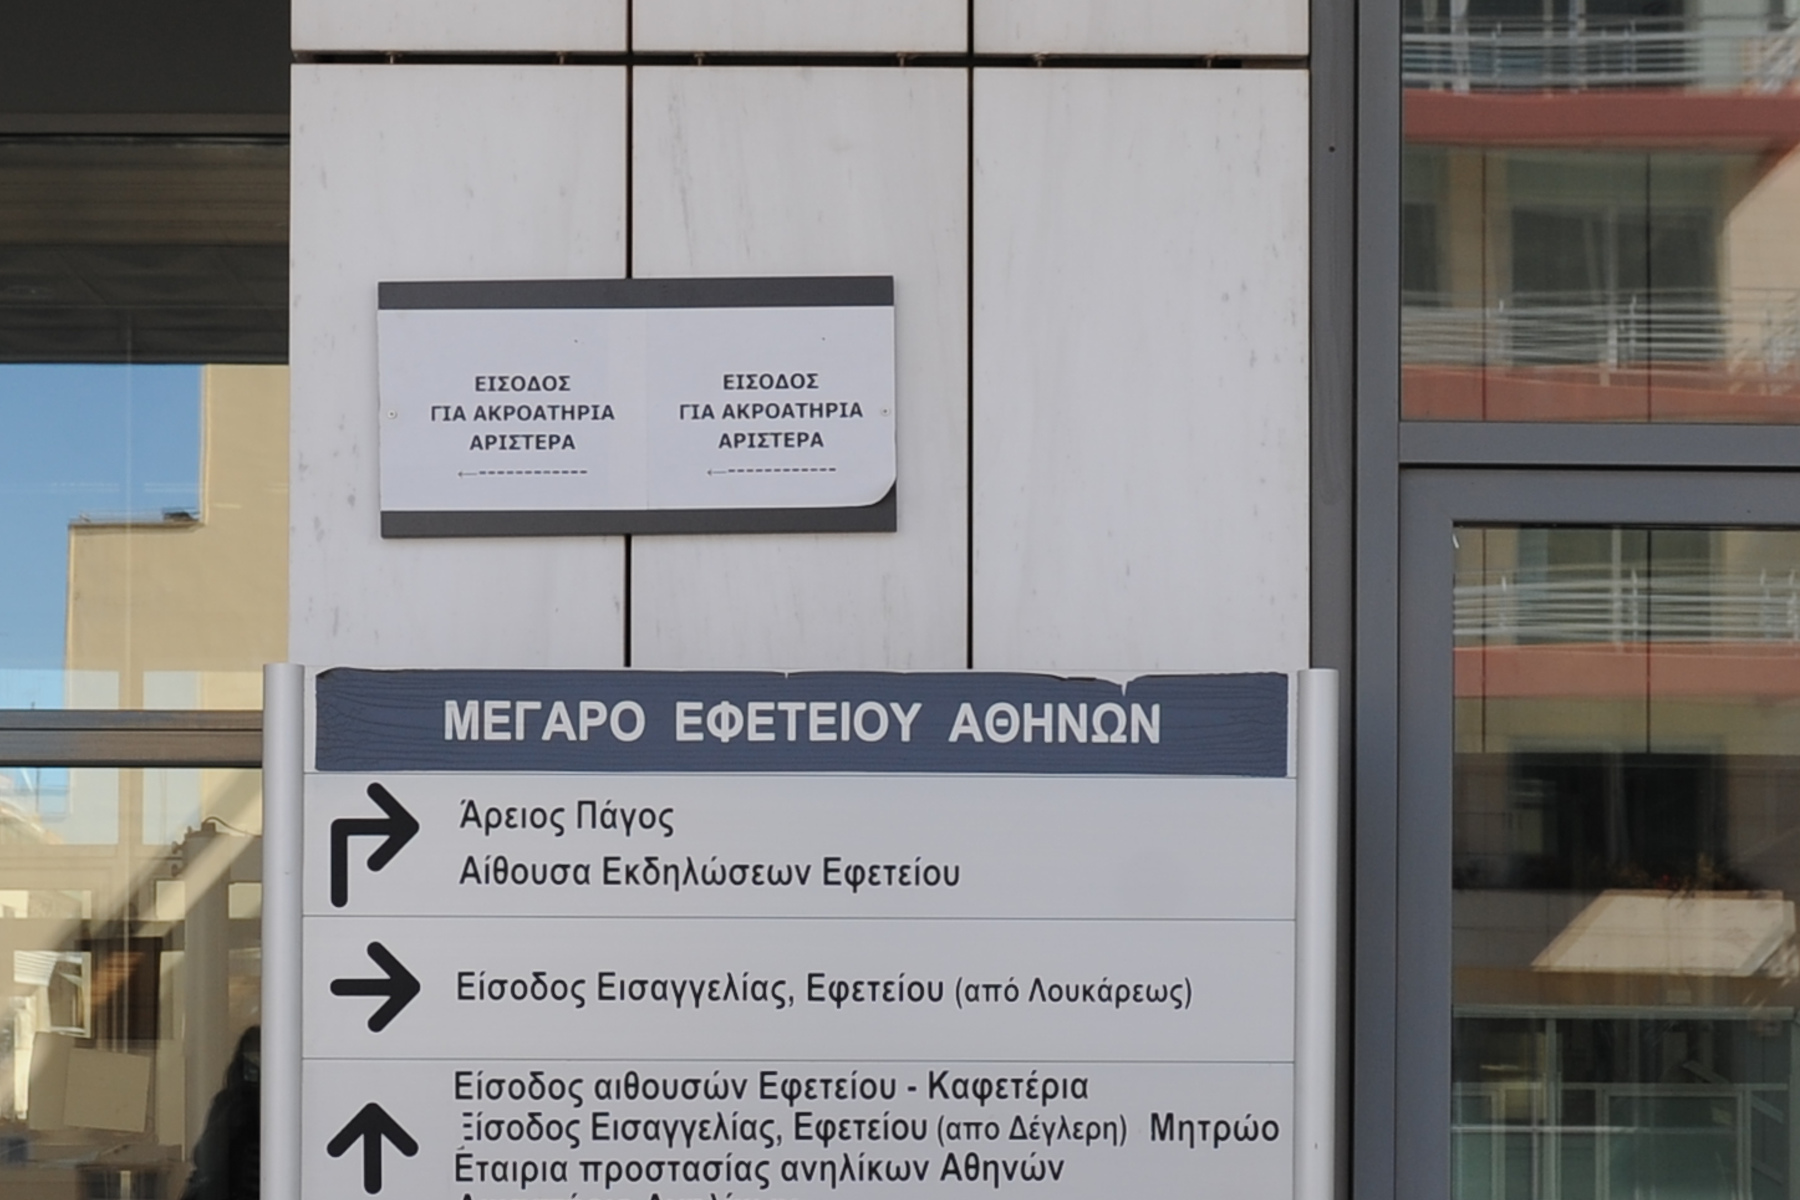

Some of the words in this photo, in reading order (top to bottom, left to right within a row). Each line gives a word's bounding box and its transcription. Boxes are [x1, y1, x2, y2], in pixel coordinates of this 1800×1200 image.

[474, 375, 571, 393] ΕΙΣΟΔΟΣ
[723, 372, 820, 391] ΕΙΣΟΔΟΣ
[430, 405, 467, 422] ΓΙΑ
[473, 404, 616, 422] ΑΚΡΟΑΤΗΡΙΑ
[679, 403, 716, 421] ΓΙΑ
[721, 401, 864, 420] ΑΚΡΟΑΤΗΡΙΑ
[469, 433, 576, 451] ΑΡΙΣΤΕΡΑ
[718, 431, 825, 449] ΑΡΙΣΤΕΡΑ
[444, 699, 646, 742] ΜΕΓΑΡΟ
[675, 700, 923, 743] ΕΦΕΤΕΙΟΥ
[948, 701, 1160, 744] ΑΘΗΝΩΝ
[459, 798, 566, 838] Άρειος
[576, 799, 674, 838] Πάγος
[458, 854, 591, 886] Αίθουσα
[602, 855, 812, 893] Εκδηλώσεων
[823, 856, 960, 894] Εφετείου
[457, 970, 587, 1009] Είσοδος
[597, 971, 795, 1010] Εισαγγελίας,
[807, 972, 944, 1010] Εφετείου
[955, 976, 1020, 1010] (από
[1028, 976, 1192, 1010] Λουκάρεως)
[454, 1070, 584, 1109] Είσοδος
[594, 1069, 748, 1101] αιθουσών
[759, 1069, 897, 1108] Εφετείου
[928, 1069, 1089, 1108] Καφετέρια
[591, 1110, 783, 1150] Εισαγγελίας,
[794, 1110, 928, 1149] Εφετείου
[937, 1114, 1001, 1148] (απο
[1008, 1114, 1127, 1147] Δέγλερη)
[1150, 1111, 1280, 1150] Μητρώο
[578, 1150, 771, 1191] προστασίας
[780, 1151, 930, 1190] ανηλίκων
[939, 1151, 1065, 1190] Αθηνών
